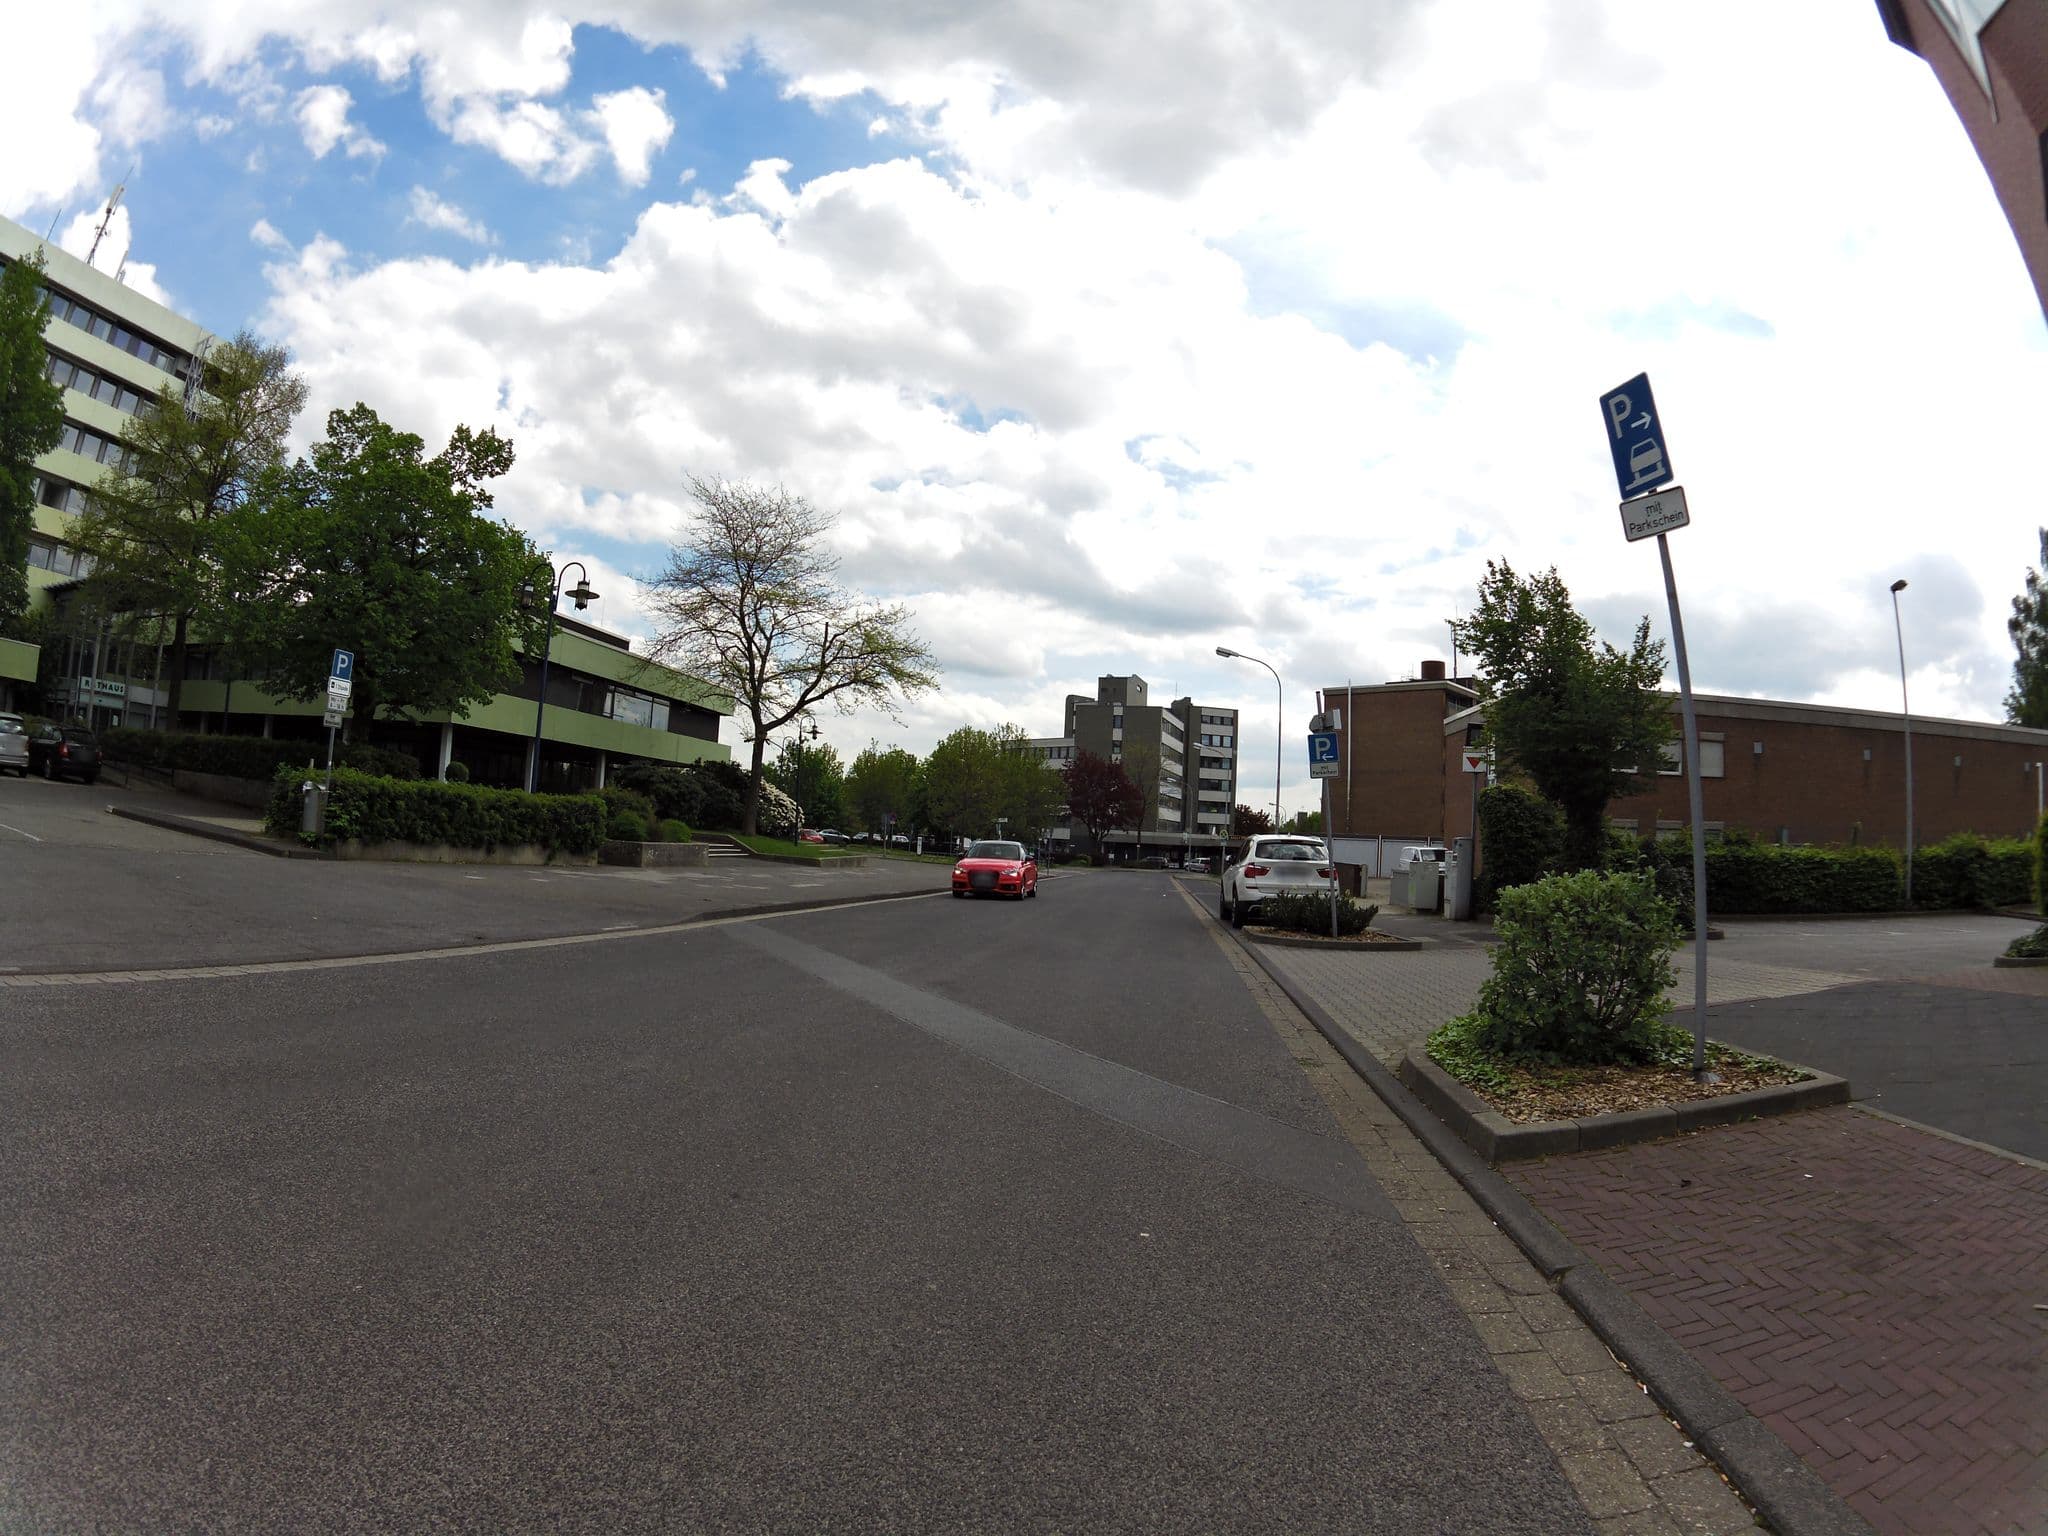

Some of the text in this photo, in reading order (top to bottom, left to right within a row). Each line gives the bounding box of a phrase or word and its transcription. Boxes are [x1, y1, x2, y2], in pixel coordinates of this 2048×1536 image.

[1608, 394, 1632, 439] P
[1645, 501, 1662, 516] mit
[1629, 510, 1684, 534] Parkschein
[336, 654, 349, 675] P
[84, 679, 124, 693] RTHAUS
[1315, 737, 1331, 760] P
